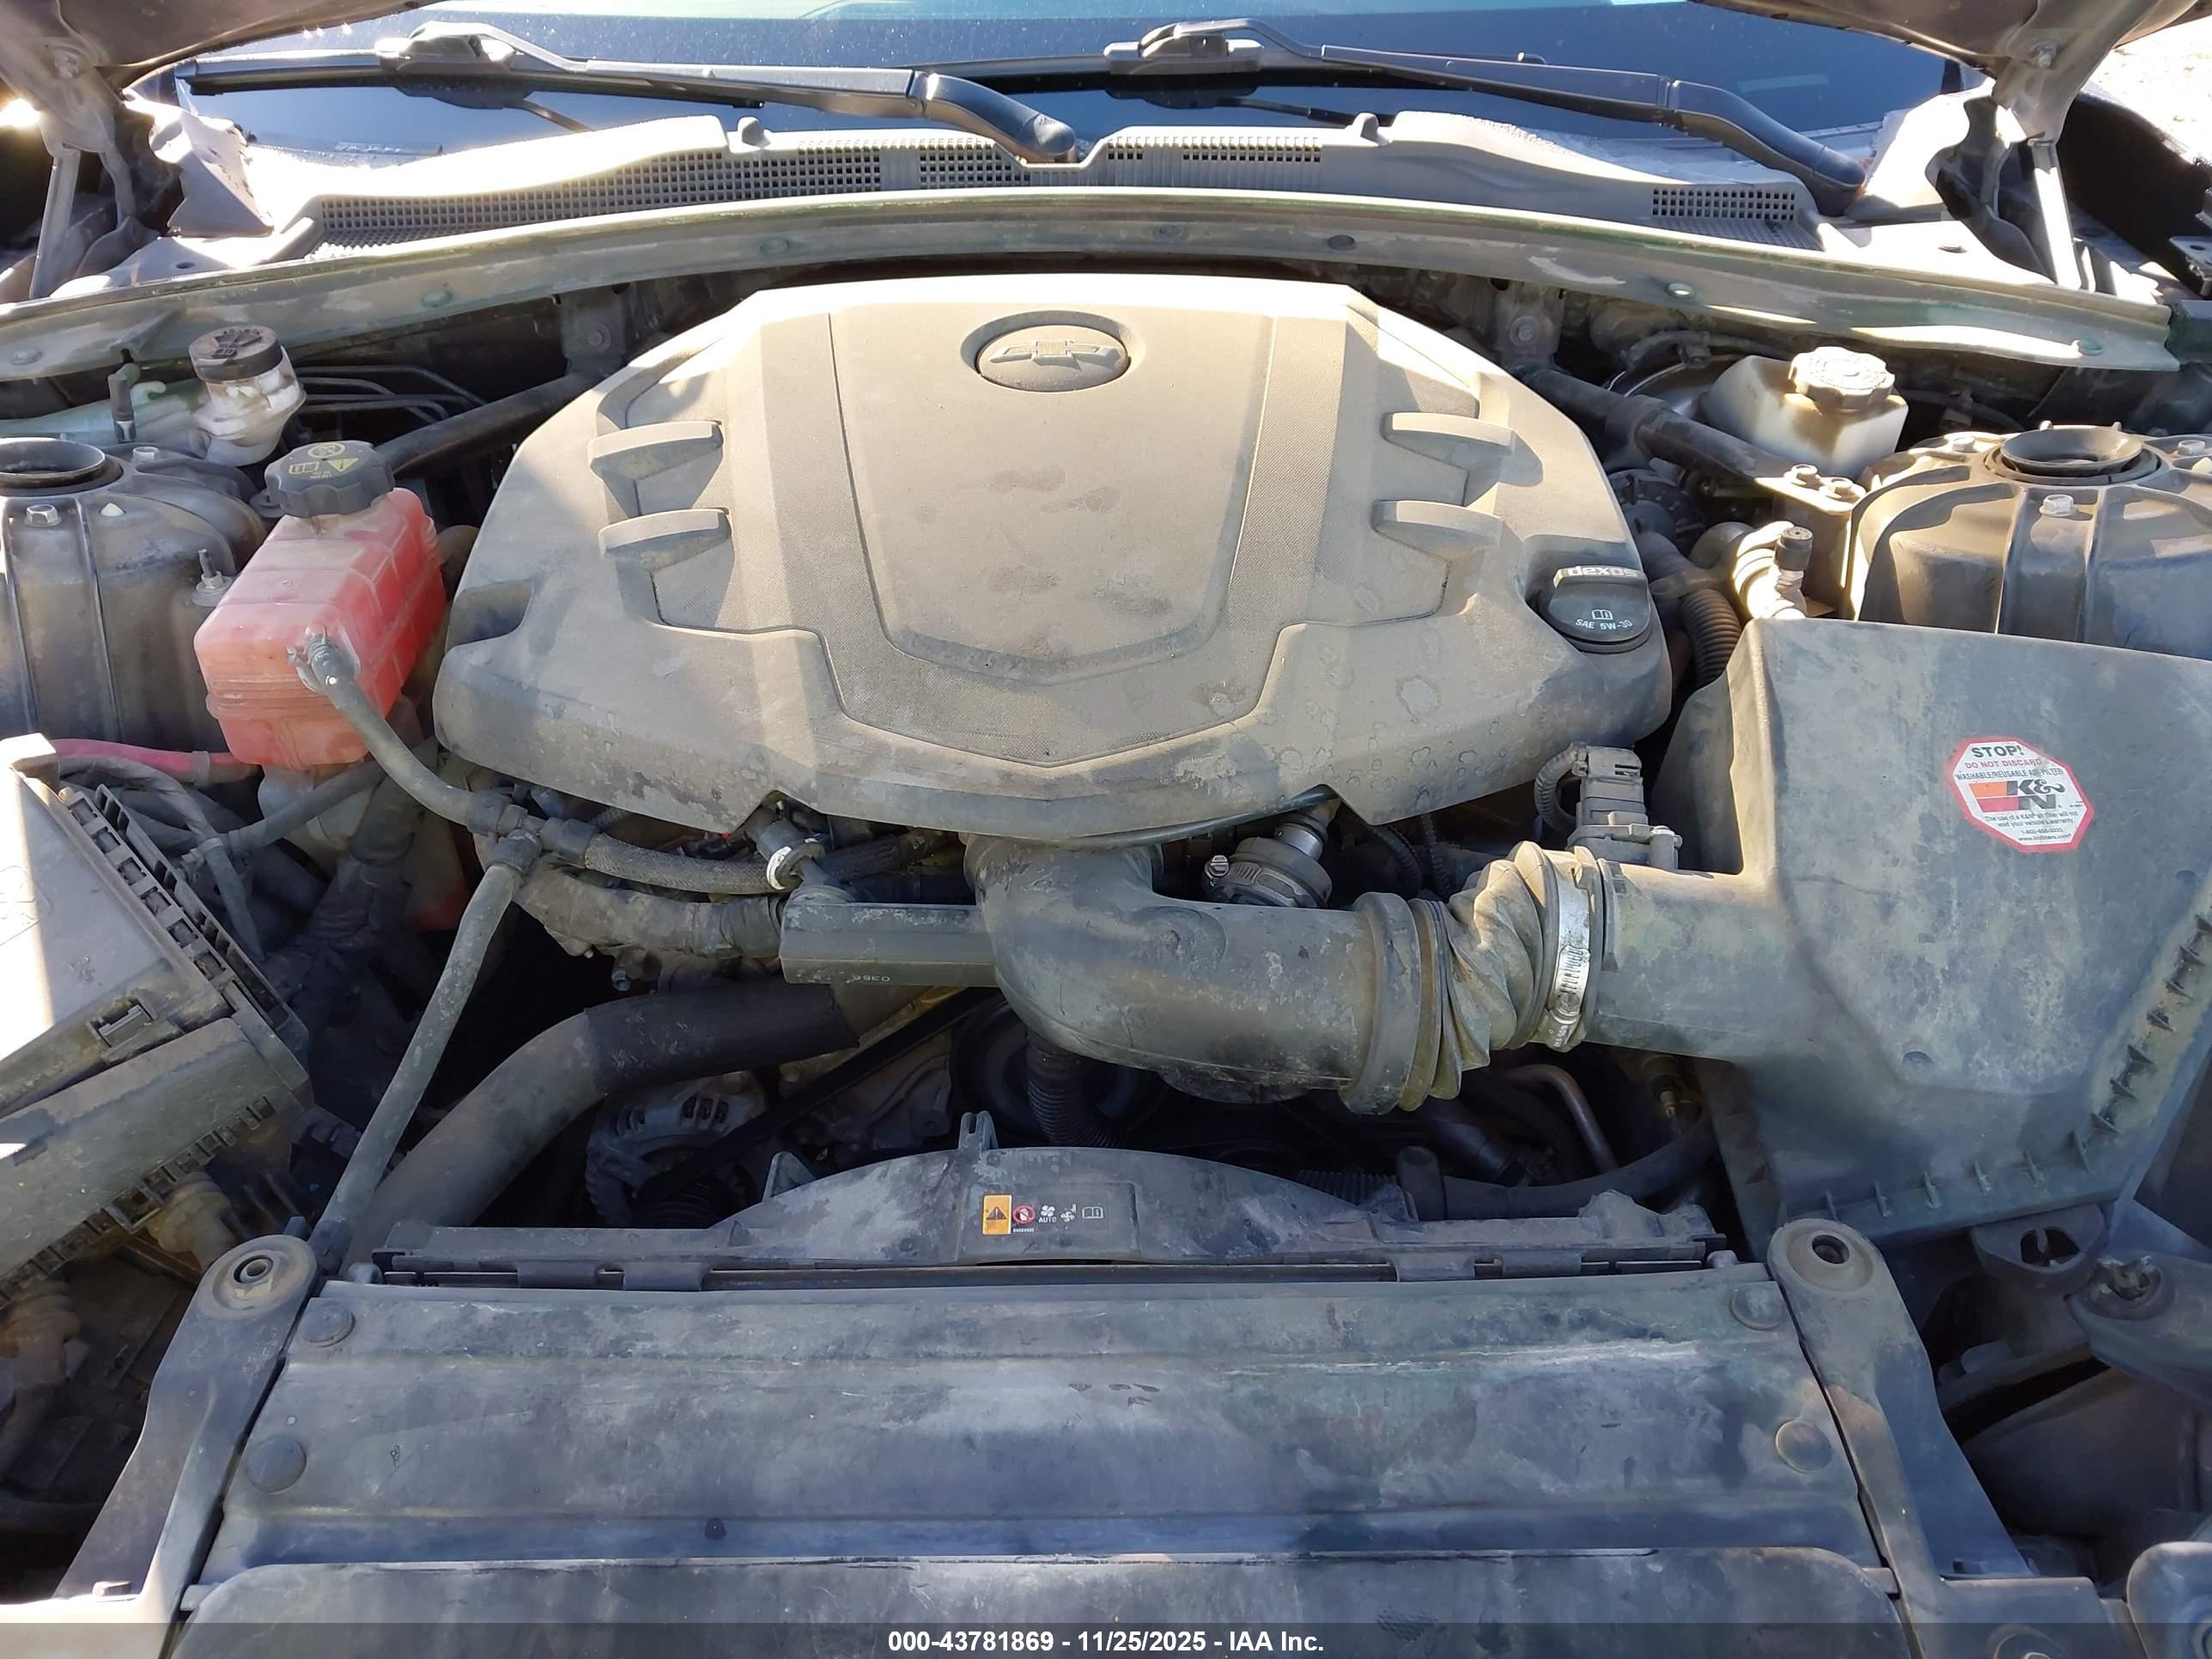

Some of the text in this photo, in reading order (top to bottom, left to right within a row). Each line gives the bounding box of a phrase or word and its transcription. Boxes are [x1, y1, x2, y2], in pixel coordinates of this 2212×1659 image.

[1568, 566, 1637, 577] dexos
[1575, 618, 1634, 630] SAE 5W-30
[1972, 745, 2024, 757] STOP!
[1981, 759, 2000, 768] NOT
[2002, 758, 2042, 767] DISCARD
[1955, 769, 2027, 781] WASHABLE/REUSABLE
[2042, 768, 2063, 776] FILTER
